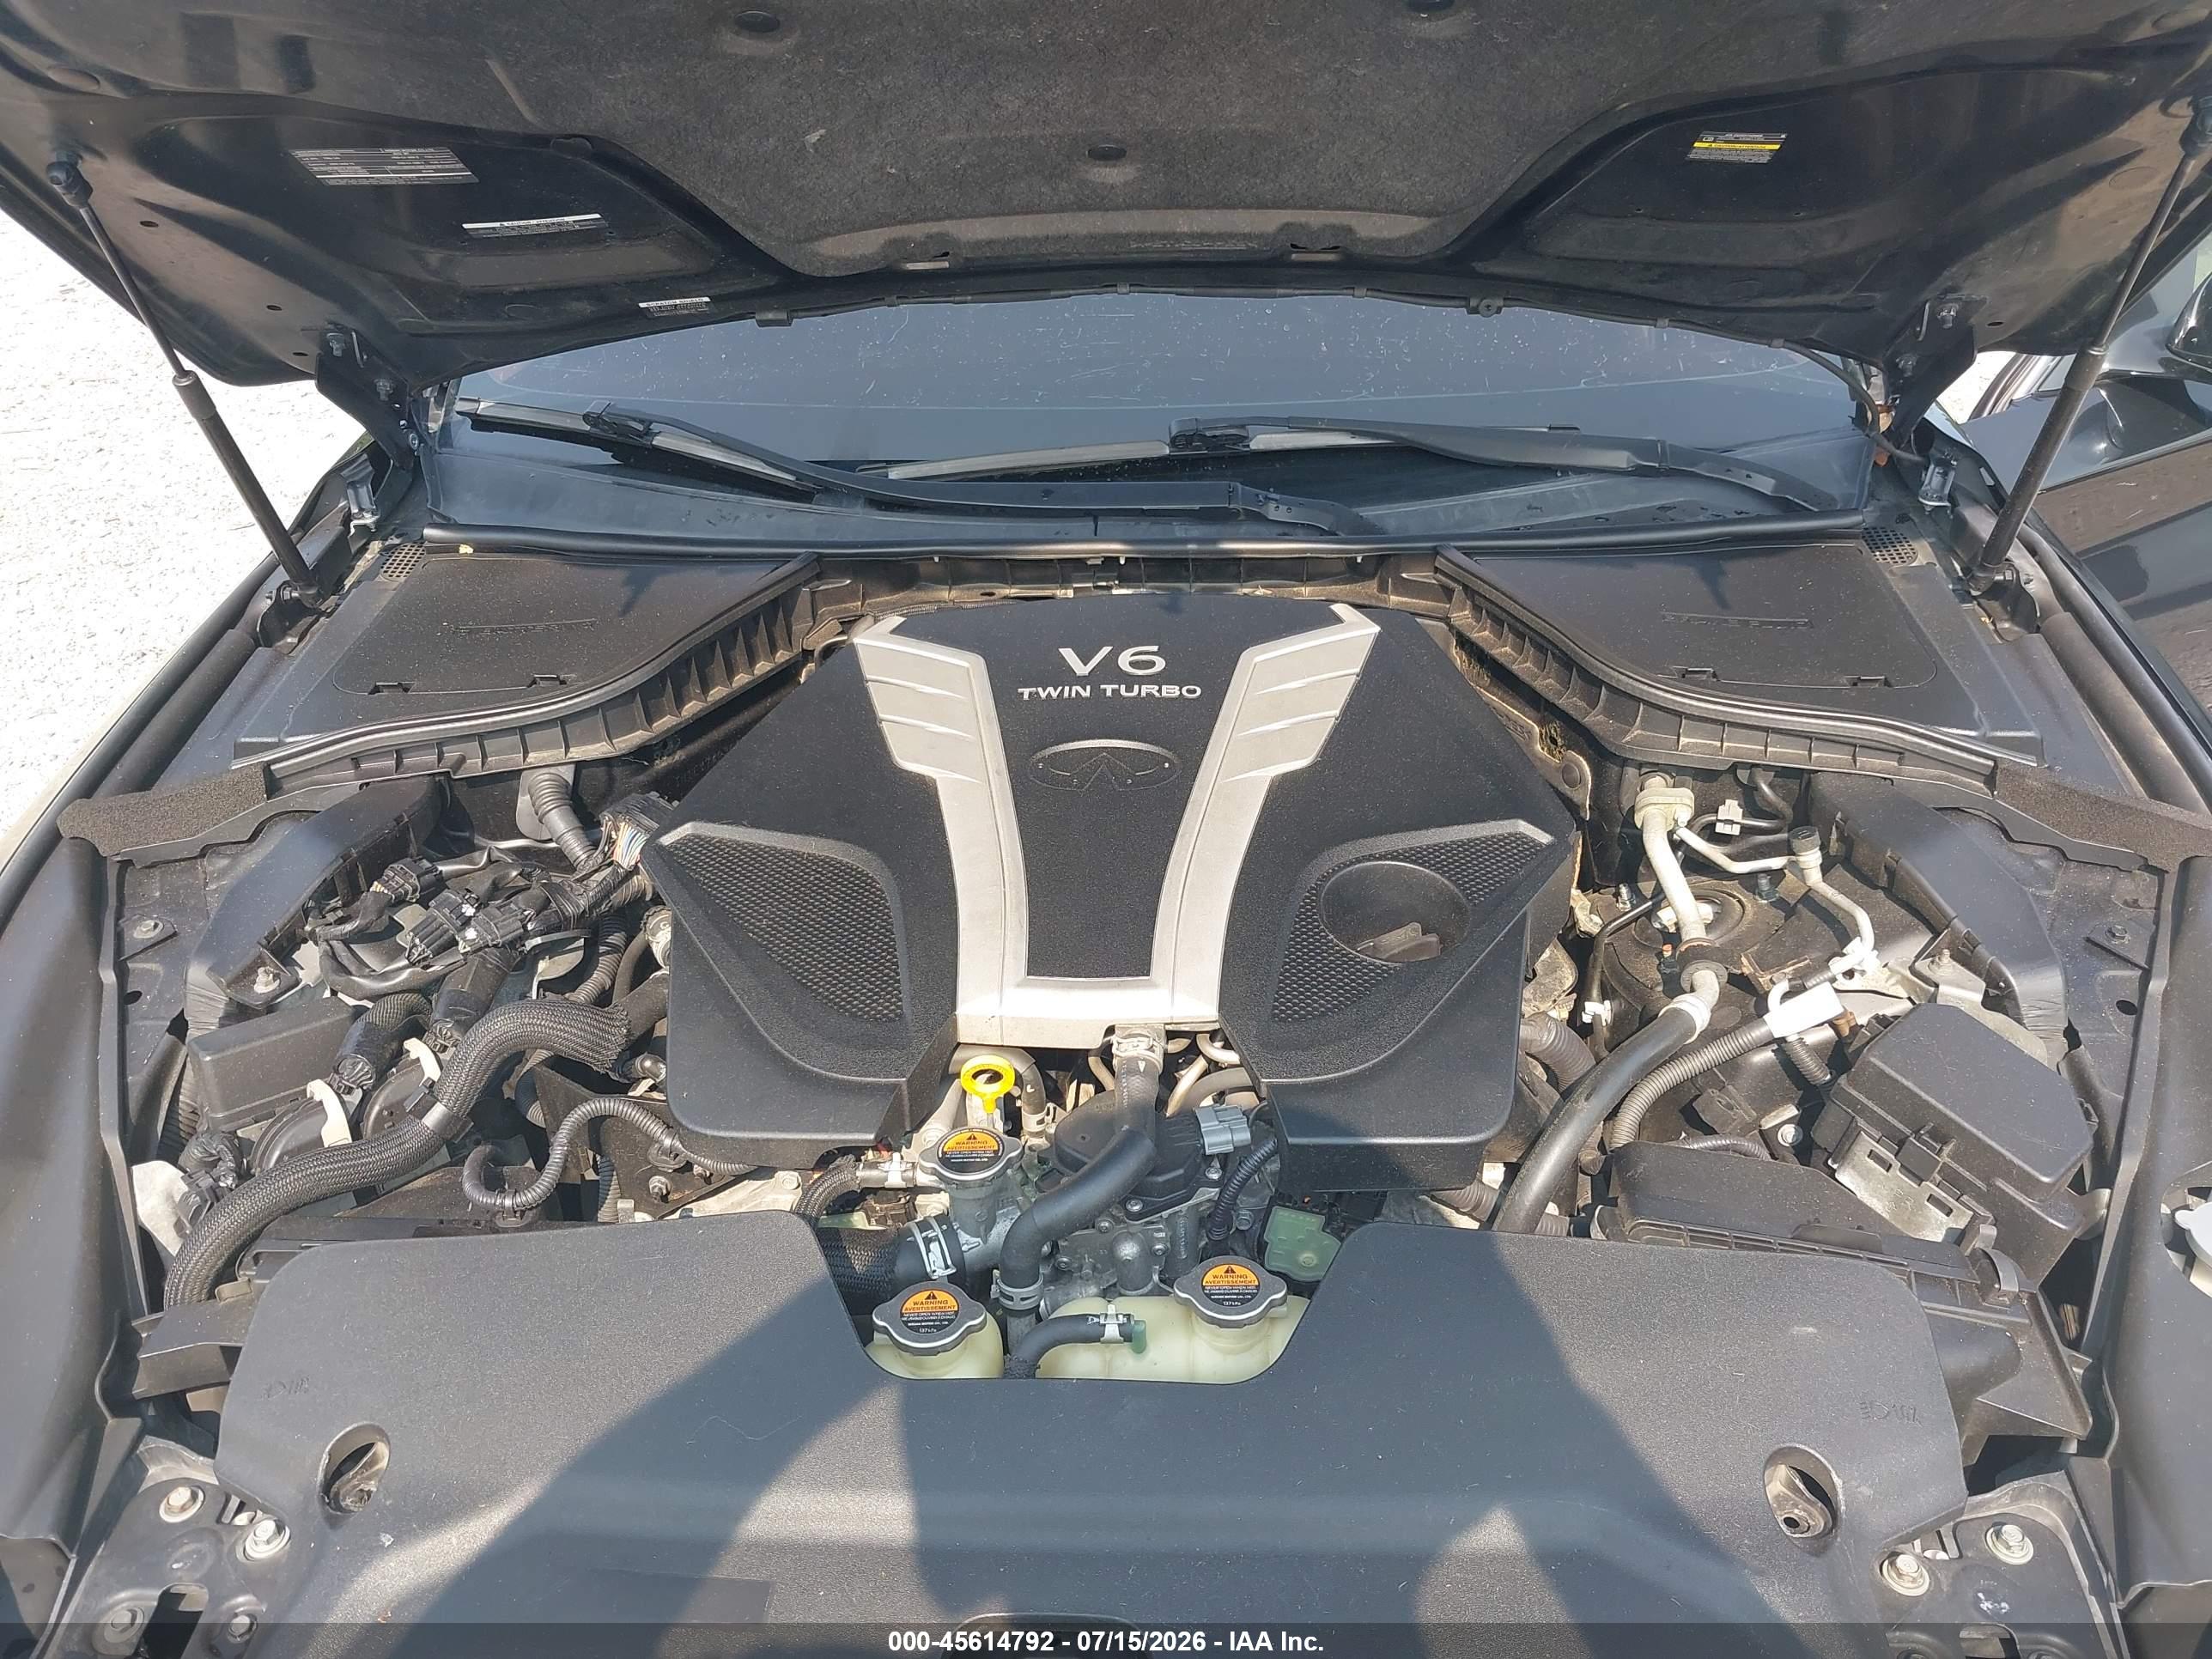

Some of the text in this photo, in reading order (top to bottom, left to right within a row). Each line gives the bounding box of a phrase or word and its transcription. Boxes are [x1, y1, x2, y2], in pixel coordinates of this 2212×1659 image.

[1058, 645, 1166, 677] V6
[1018, 684, 1201, 701] TWIN TURBO
